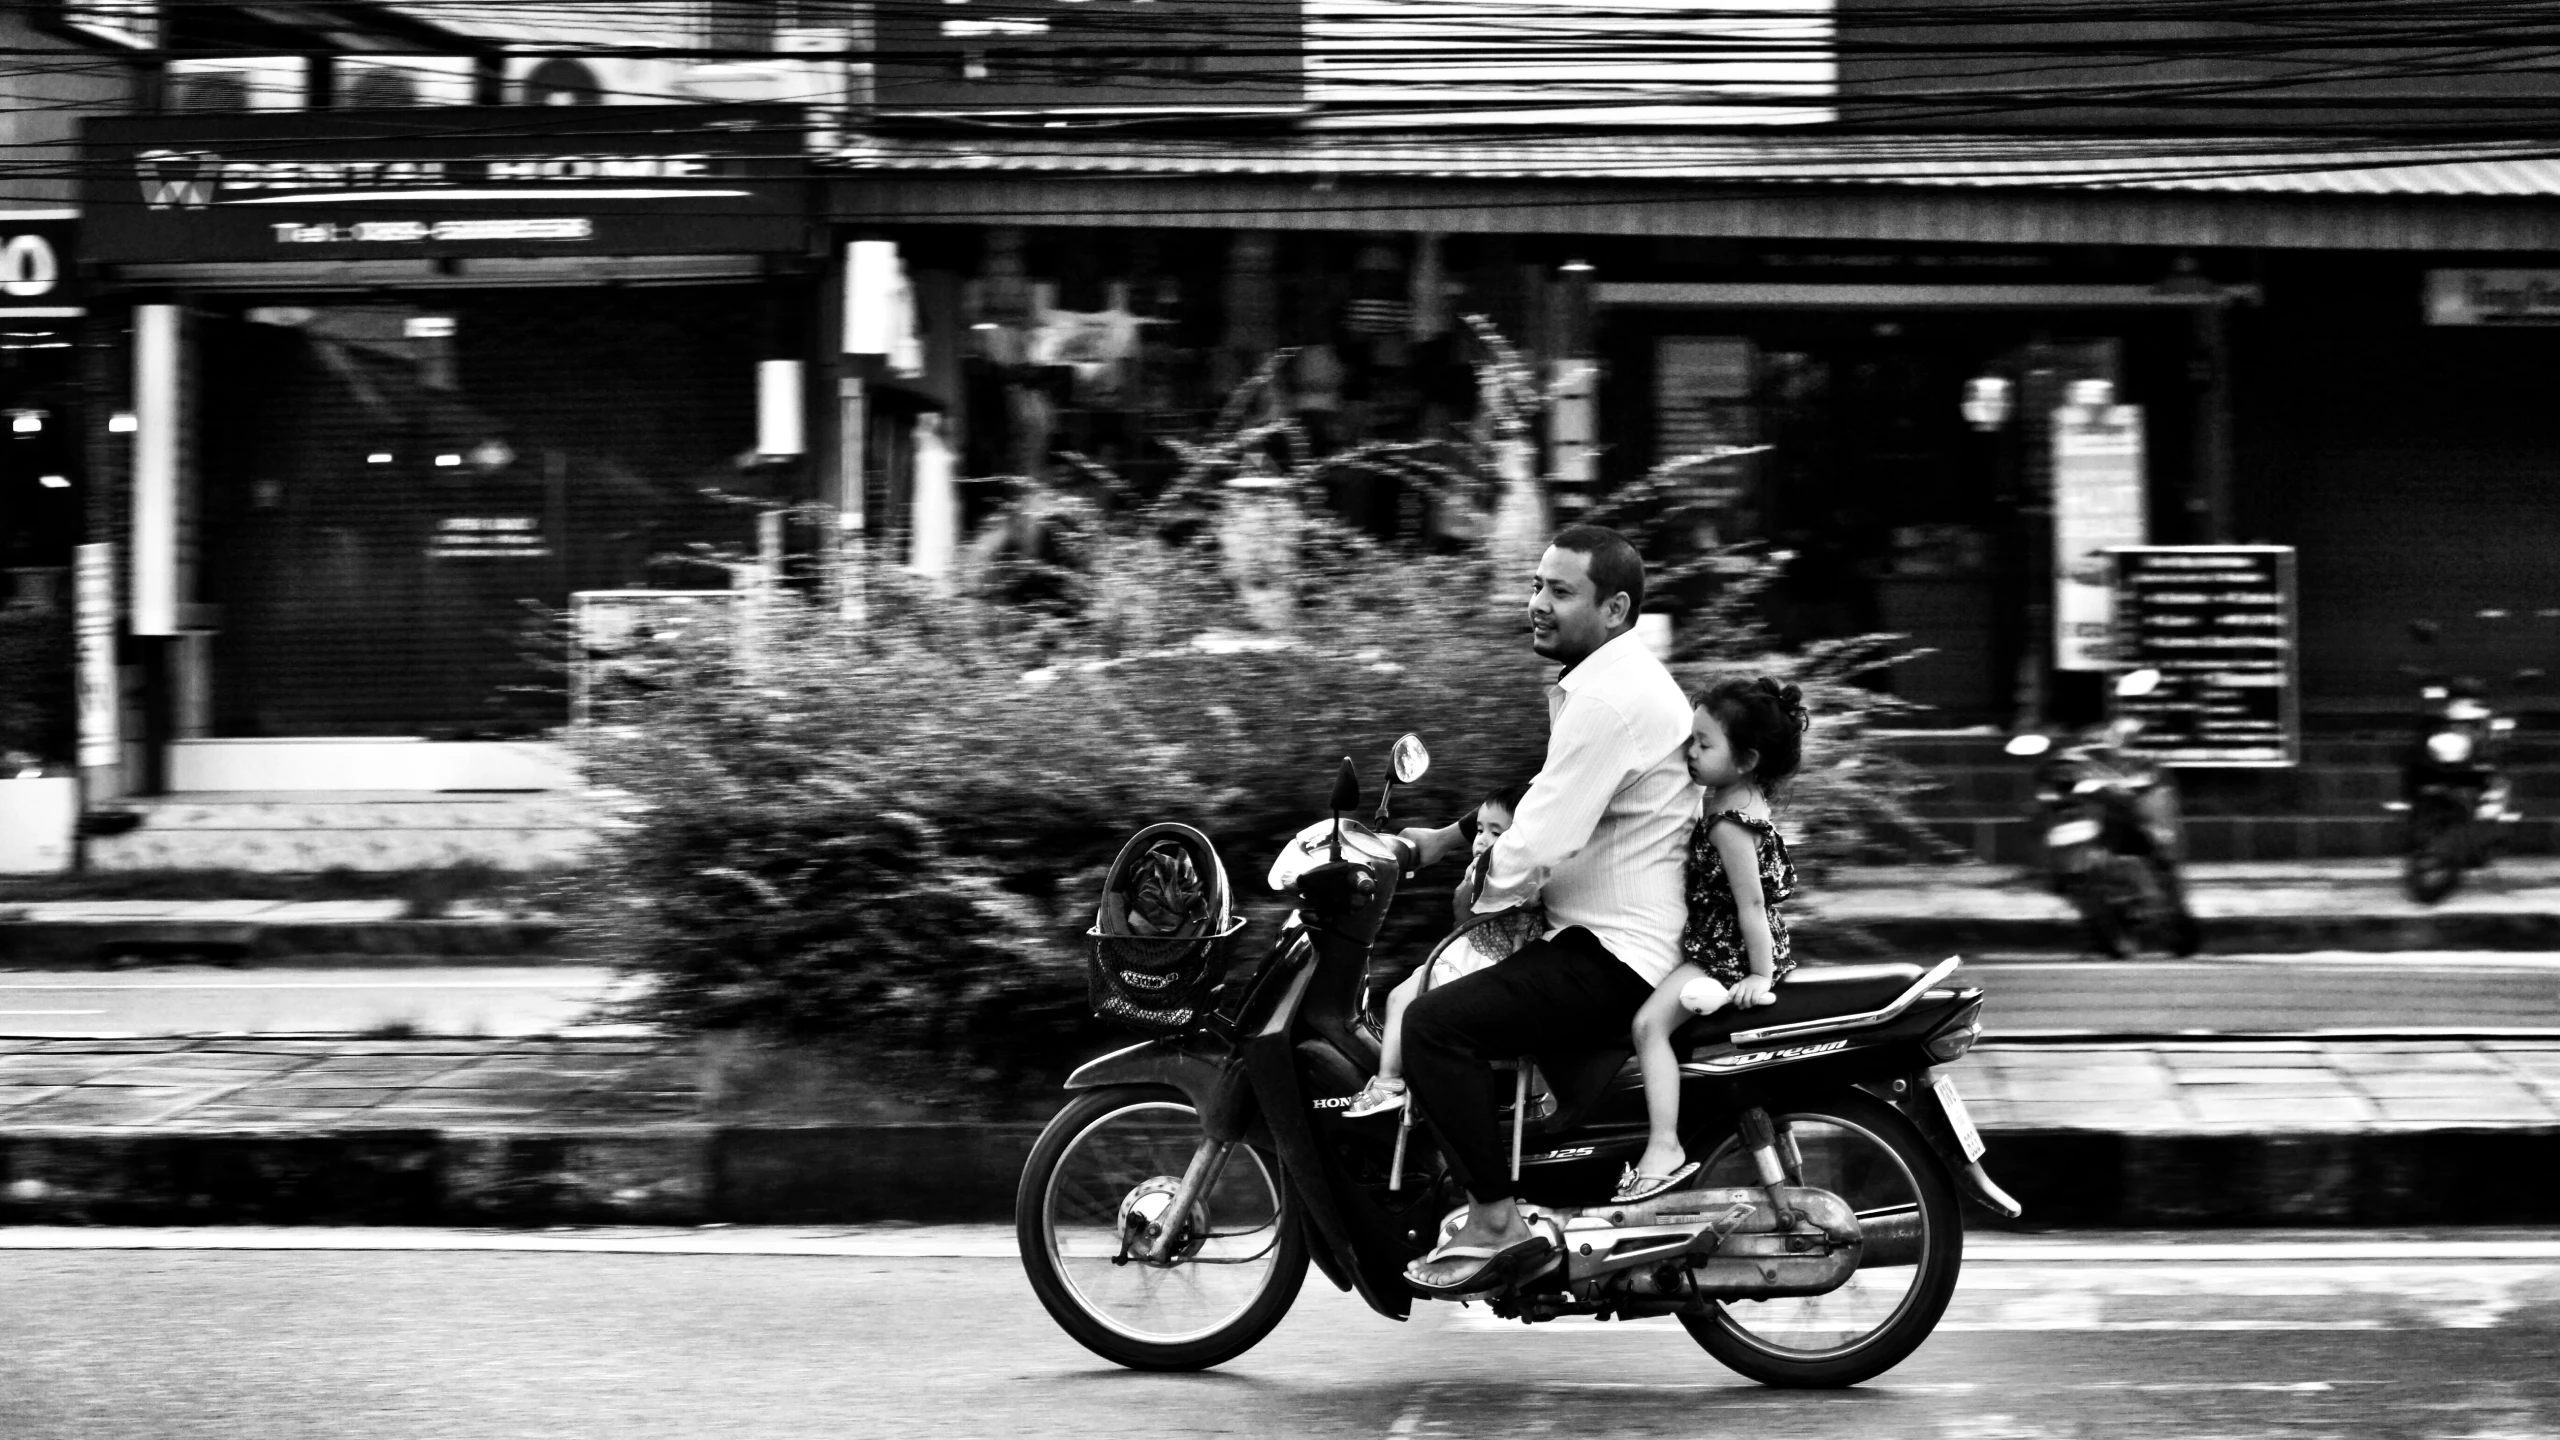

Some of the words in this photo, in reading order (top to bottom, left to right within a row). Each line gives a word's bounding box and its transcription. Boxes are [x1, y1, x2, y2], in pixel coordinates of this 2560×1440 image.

[221, 161, 456, 190] DENTAL
[486, 154, 710, 181] HOME
[1734, 1039, 1848, 1066] Dream
[1549, 1147, 1595, 1158] 125
